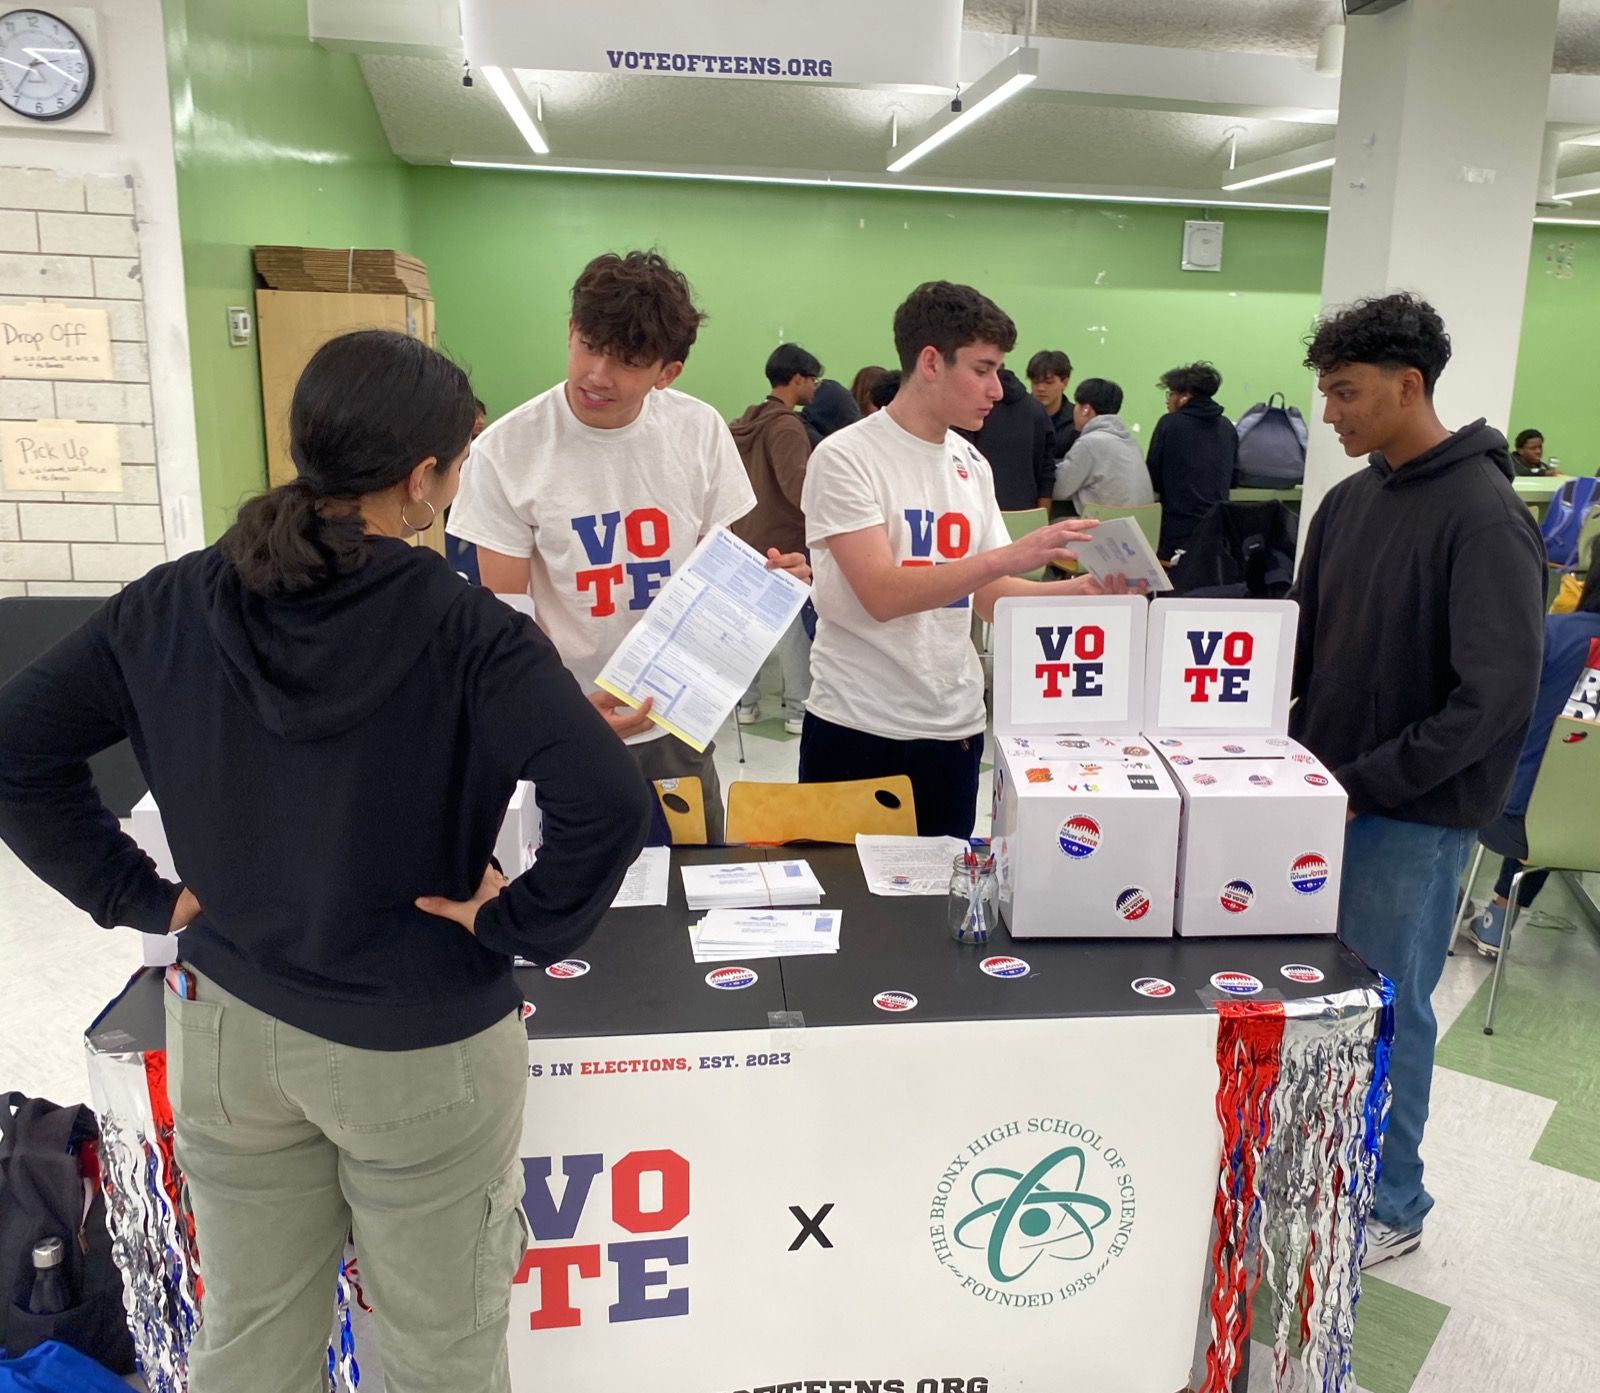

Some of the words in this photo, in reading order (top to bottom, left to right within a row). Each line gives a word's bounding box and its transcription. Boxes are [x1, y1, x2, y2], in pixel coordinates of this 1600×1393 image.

[27, 16, 39, 28] 12
[75, 62, 84, 73] 3
[606, 50, 833, 77] VOTEOFTEENS.ORG
[35, 102, 44, 113] 6
[57, 98, 65, 109] 5
[0, 322, 44, 351] Drop
[50, 322, 87, 348] Off
[15, 437, 59, 464] Pick
[62, 438, 89, 466] Up
[551, 1063, 573, 1076] IN
[580, 1057, 692, 1075] ELECTIONS,
[699, 1056, 739, 1069] EST.
[745, 1052, 791, 1067] 2023
[966, 1120, 1022, 1157] HIGH
[1027, 1117, 1105, 1151] SCHOOL
[1103, 1147, 1126, 1171] OF
[930, 1154, 970, 1220] BRONX
[1117, 1173, 1136, 1258] SCIENCE
[930, 1224, 953, 1265] THE
[960, 1274, 1054, 1308] FOUNDED
[1059, 1272, 1098, 1301] 1938
